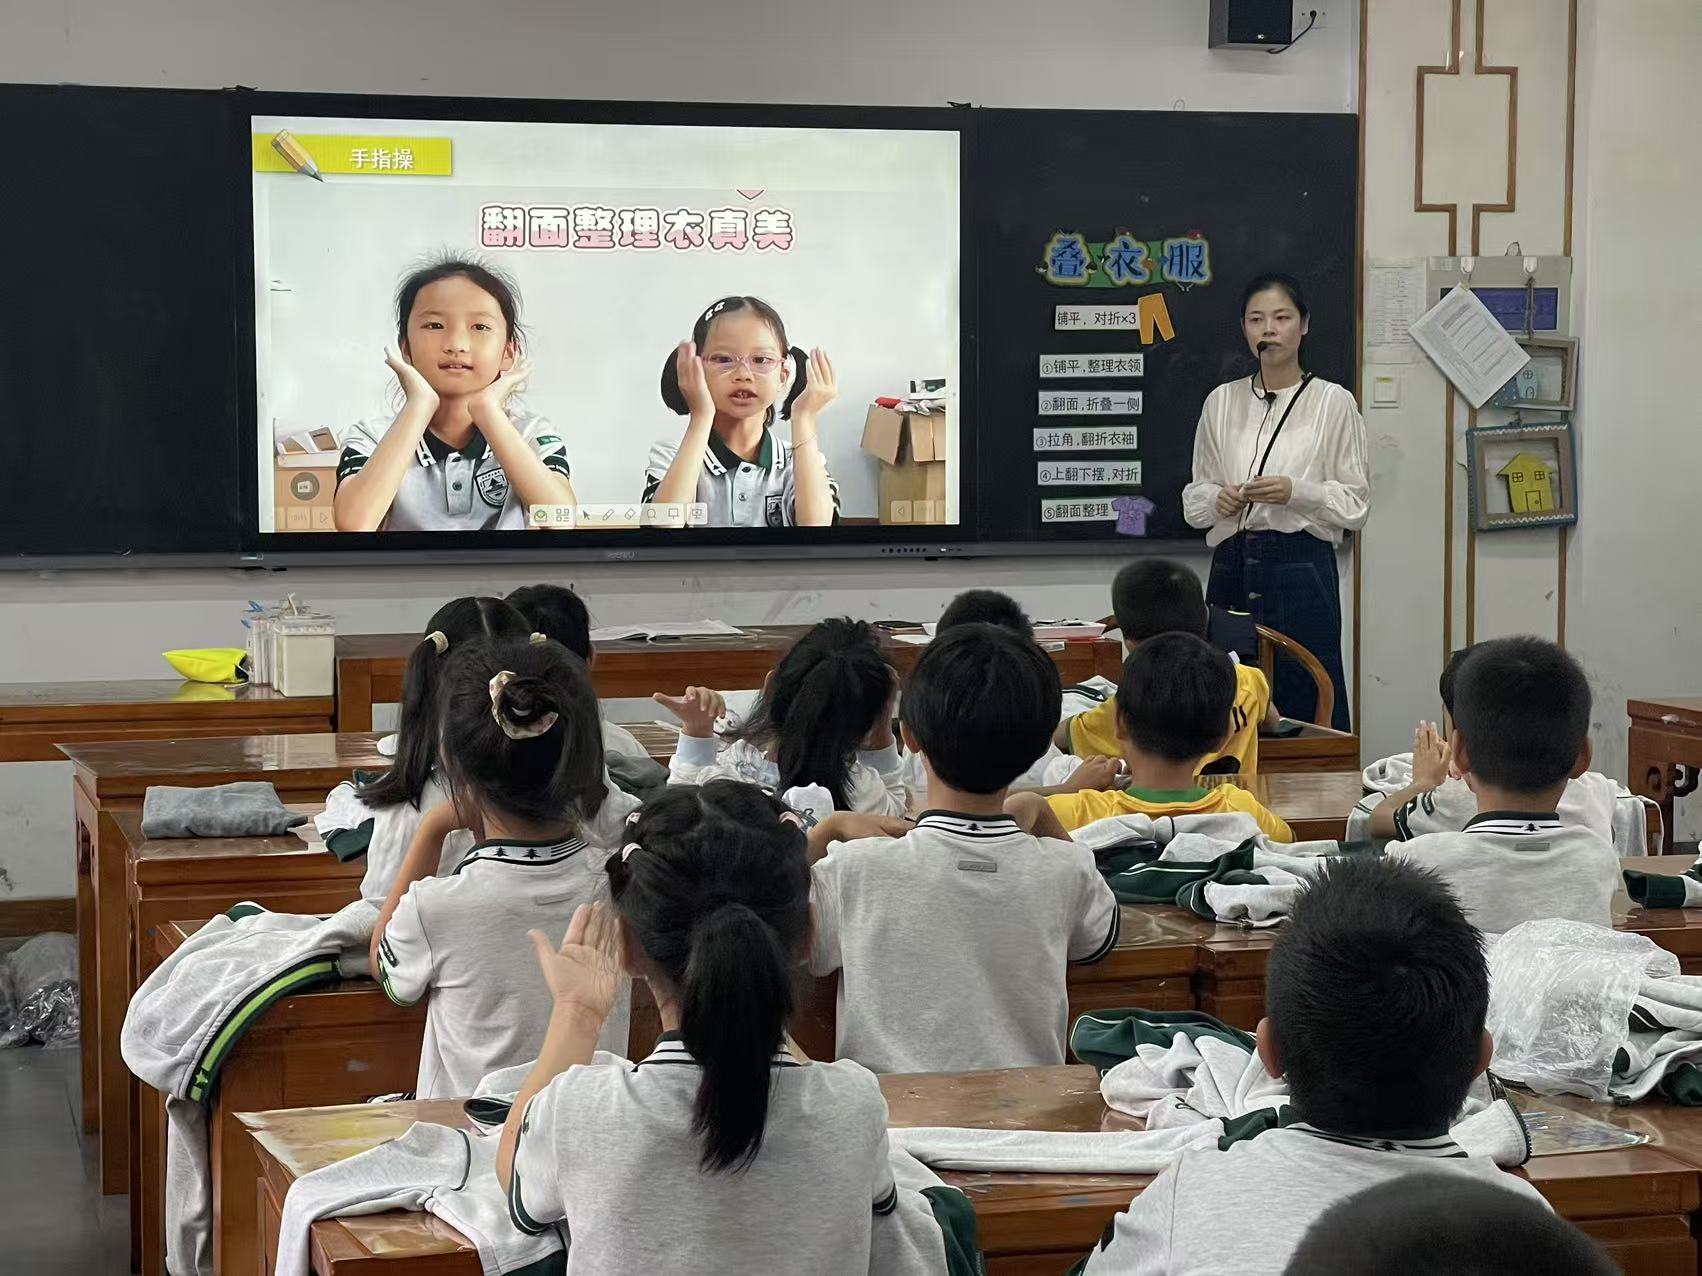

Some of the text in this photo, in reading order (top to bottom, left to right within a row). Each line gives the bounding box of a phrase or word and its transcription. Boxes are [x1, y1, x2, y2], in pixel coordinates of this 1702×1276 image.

[349, 147, 414, 171] 手指操
[481, 205, 795, 251] 翻面整理衣真美
[1050, 238, 1205, 279] 叠衣服
[1043, 503, 1109, 520] ⑤翻面整理
